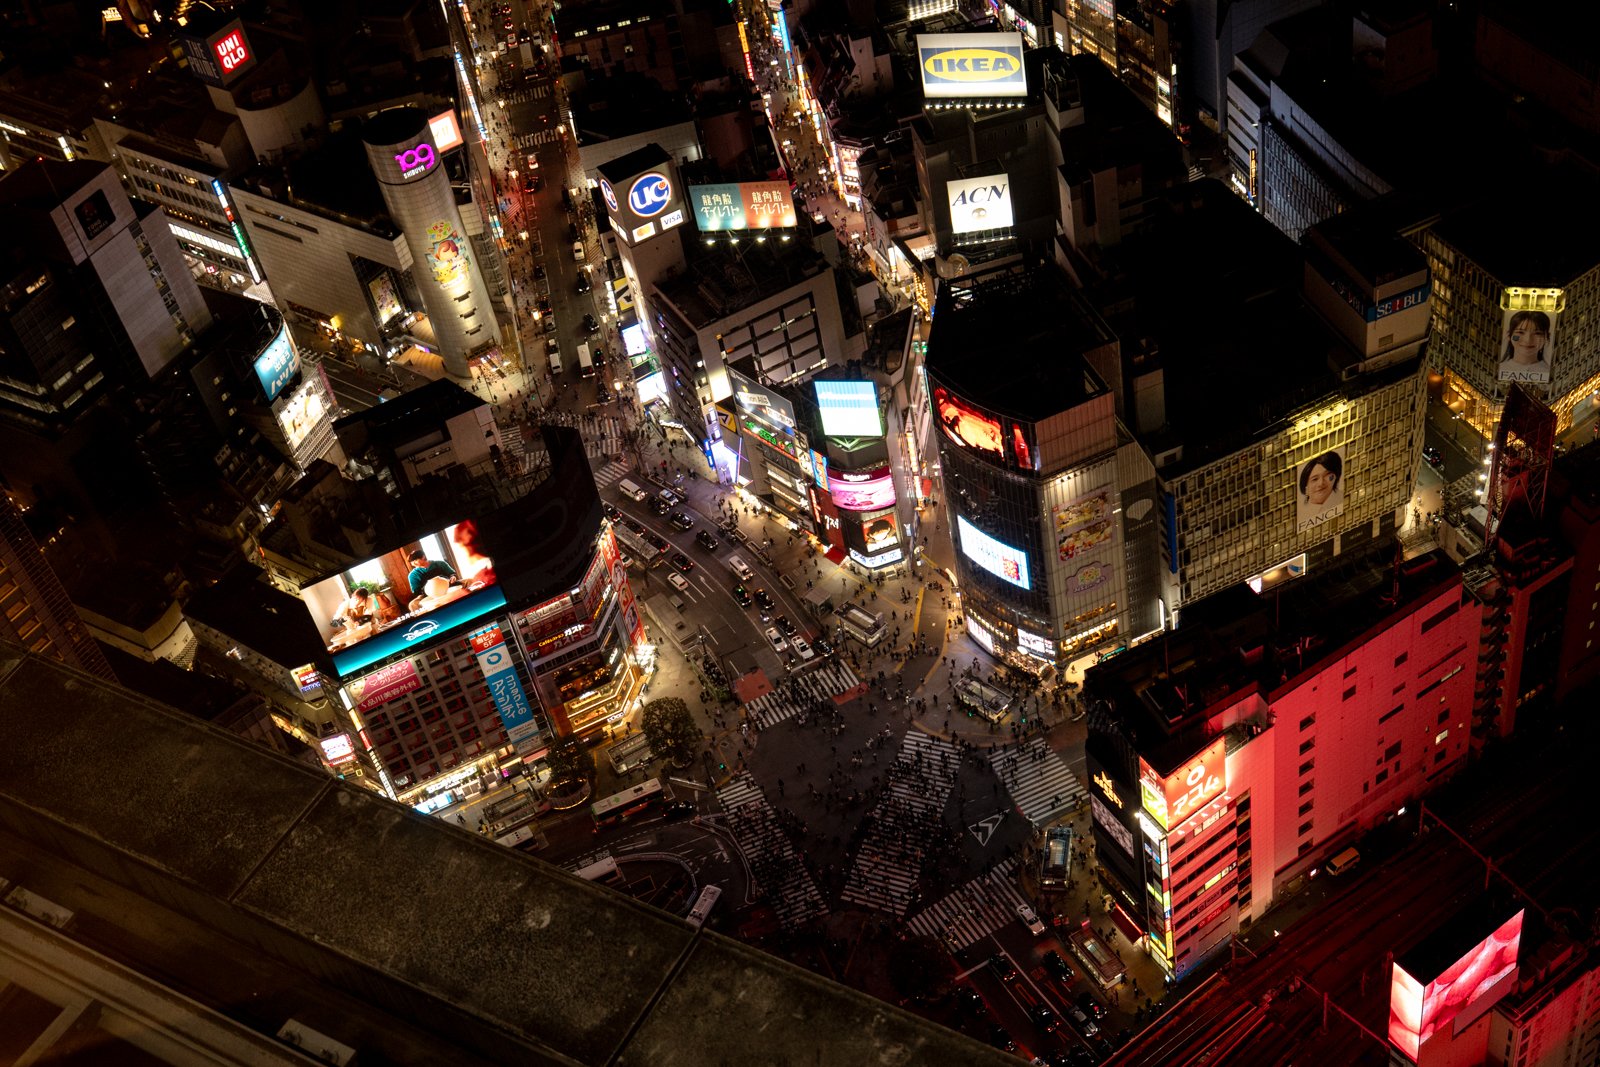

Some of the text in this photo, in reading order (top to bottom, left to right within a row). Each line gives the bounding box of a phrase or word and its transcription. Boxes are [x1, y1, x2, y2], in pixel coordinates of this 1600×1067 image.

[216, 34, 240, 57] UNI
[222, 46, 246, 70] QLO
[932, 57, 1014, 73] IKEA
[395, 143, 435, 173] 109
[632, 179, 669, 210] UC
[952, 183, 1008, 207] ACN
[663, 213, 682, 226] VISA
[1376, 291, 1422, 318] SEIBU
[1500, 370, 1546, 381] FANCL
[1298, 506, 1342, 532] FANCL
[402, 621, 441, 642] Disney+
[1173, 774, 1220, 816] アコム
